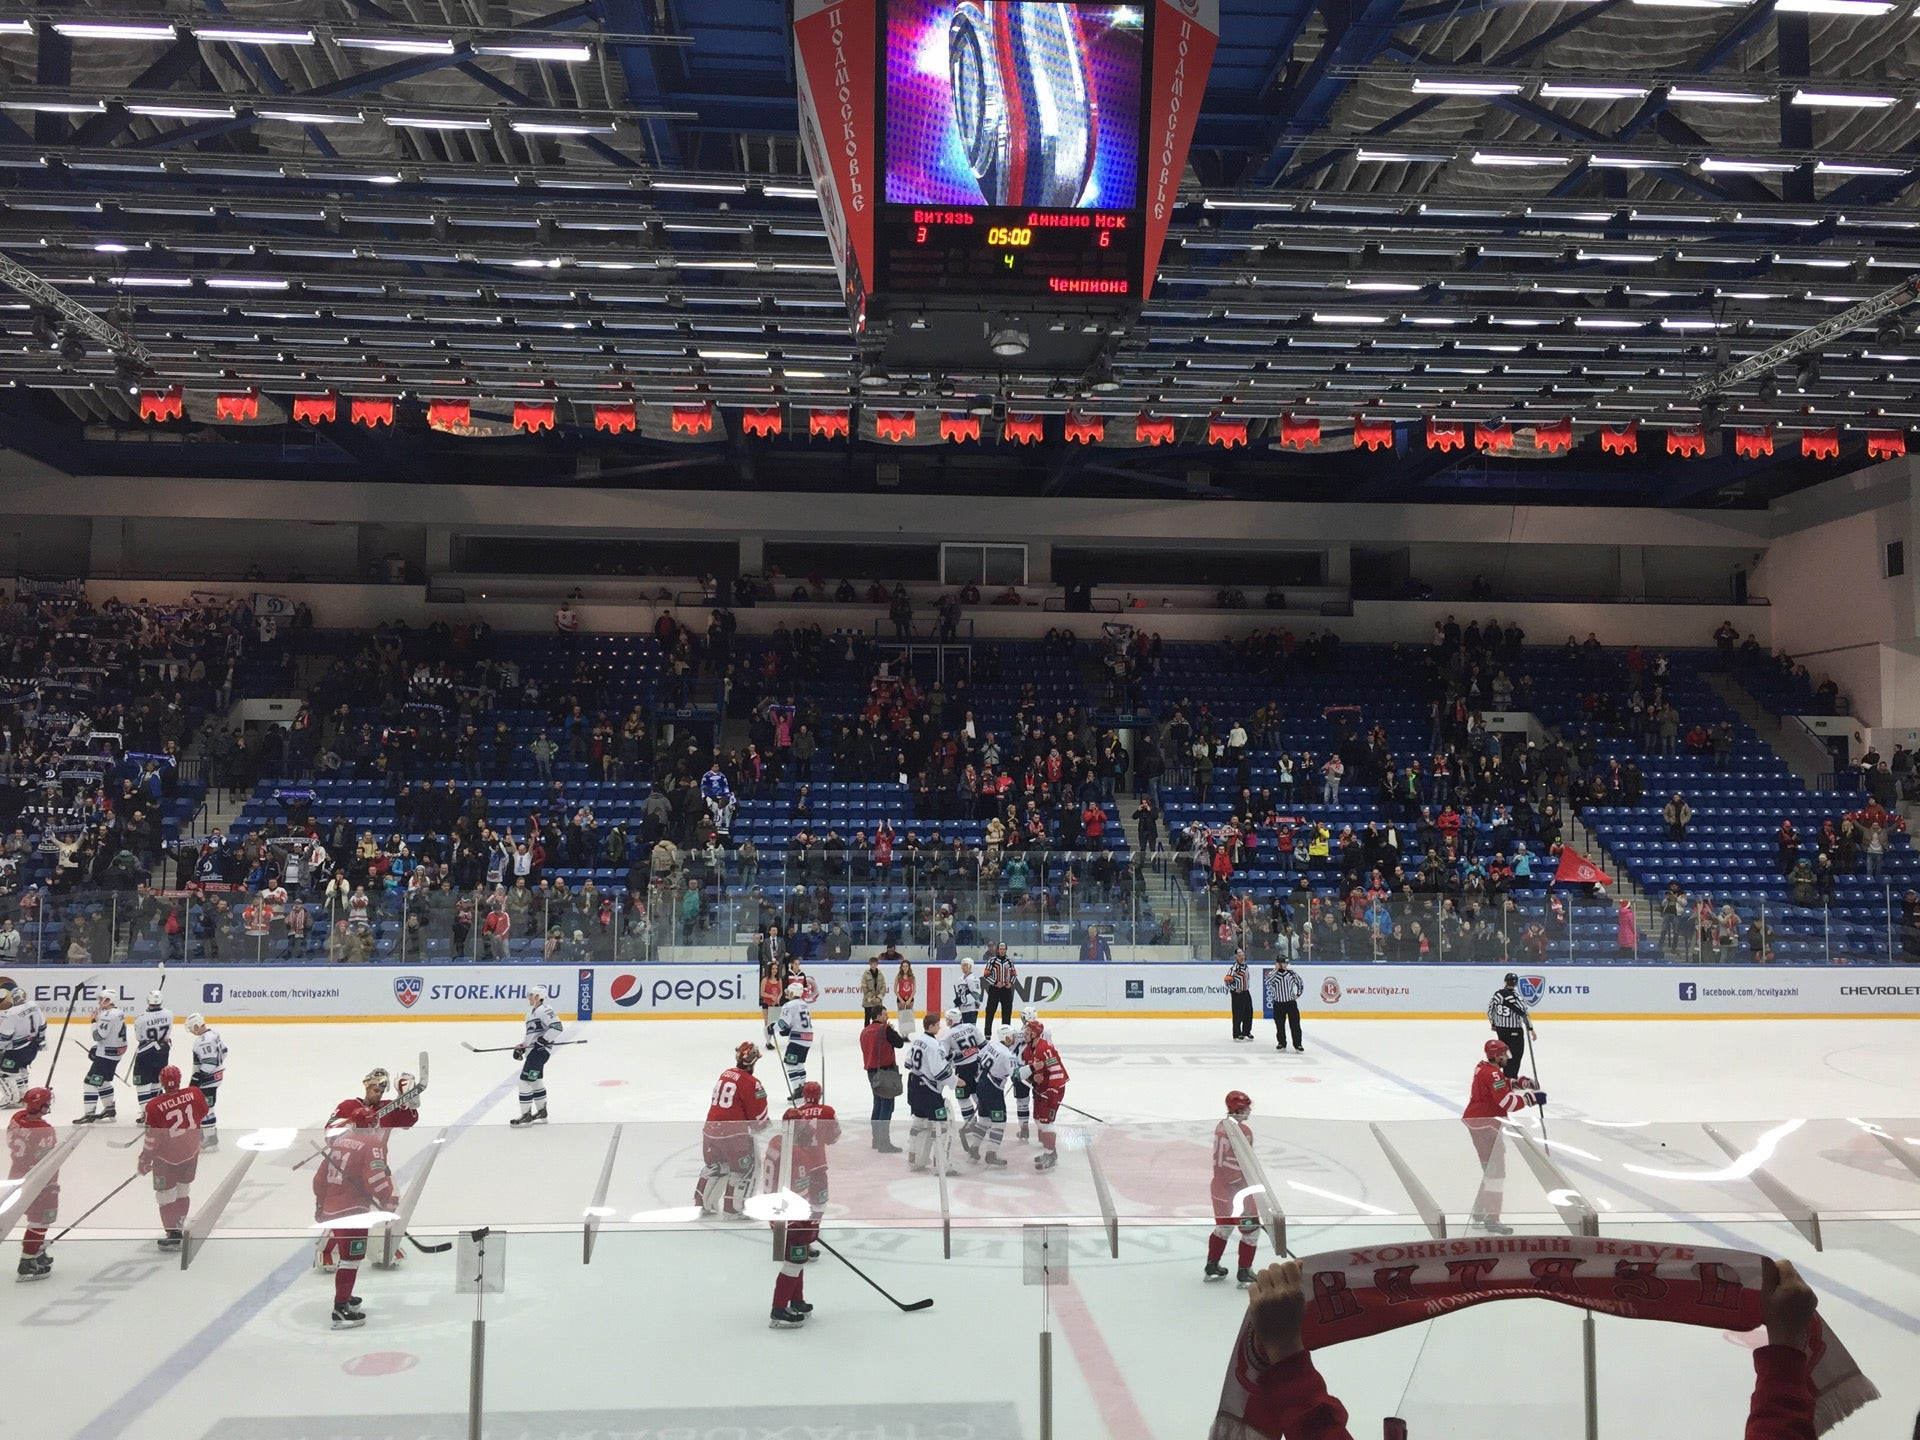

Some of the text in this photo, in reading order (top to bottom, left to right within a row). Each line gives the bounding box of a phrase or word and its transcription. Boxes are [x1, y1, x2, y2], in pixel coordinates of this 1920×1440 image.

[829, 8, 864, 212] ПОДМОСКОВЬЕ
[1154, 20, 1192, 220] ПОДМОСКОВЬЕ
[914, 210, 974, 225] Витязь
[1027, 213, 1126, 229] Динамо Мск
[917, 227, 927, 242] 3
[988, 228, 1031, 245] 05:00
[1099, 231, 1110, 247] 6
[1004, 254, 1014, 269] 4
[1050, 276, 1128, 293] Чемпиона
[229, 989, 340, 999] facebook.com/hcvityazkhl
[652, 974, 743, 1007] pepsi
[1346, 986, 1410, 996] www.hcvityaz.ru
[1548, 985, 1590, 994] КХЛ ТВ
[1702, 988, 1799, 997] facebook.com/hcvityazkhl
[1841, 986, 1920, 995] CHEVROLET
[580, 984, 591, 1011] pepsi
[1497, 1004, 1510, 1016] 83
[1043, 1048, 1053, 1059] 17
[1492, 1071, 1501, 1081] 5
[165, 1103, 197, 1138] 21
[372, 1147, 385, 1160] 61
